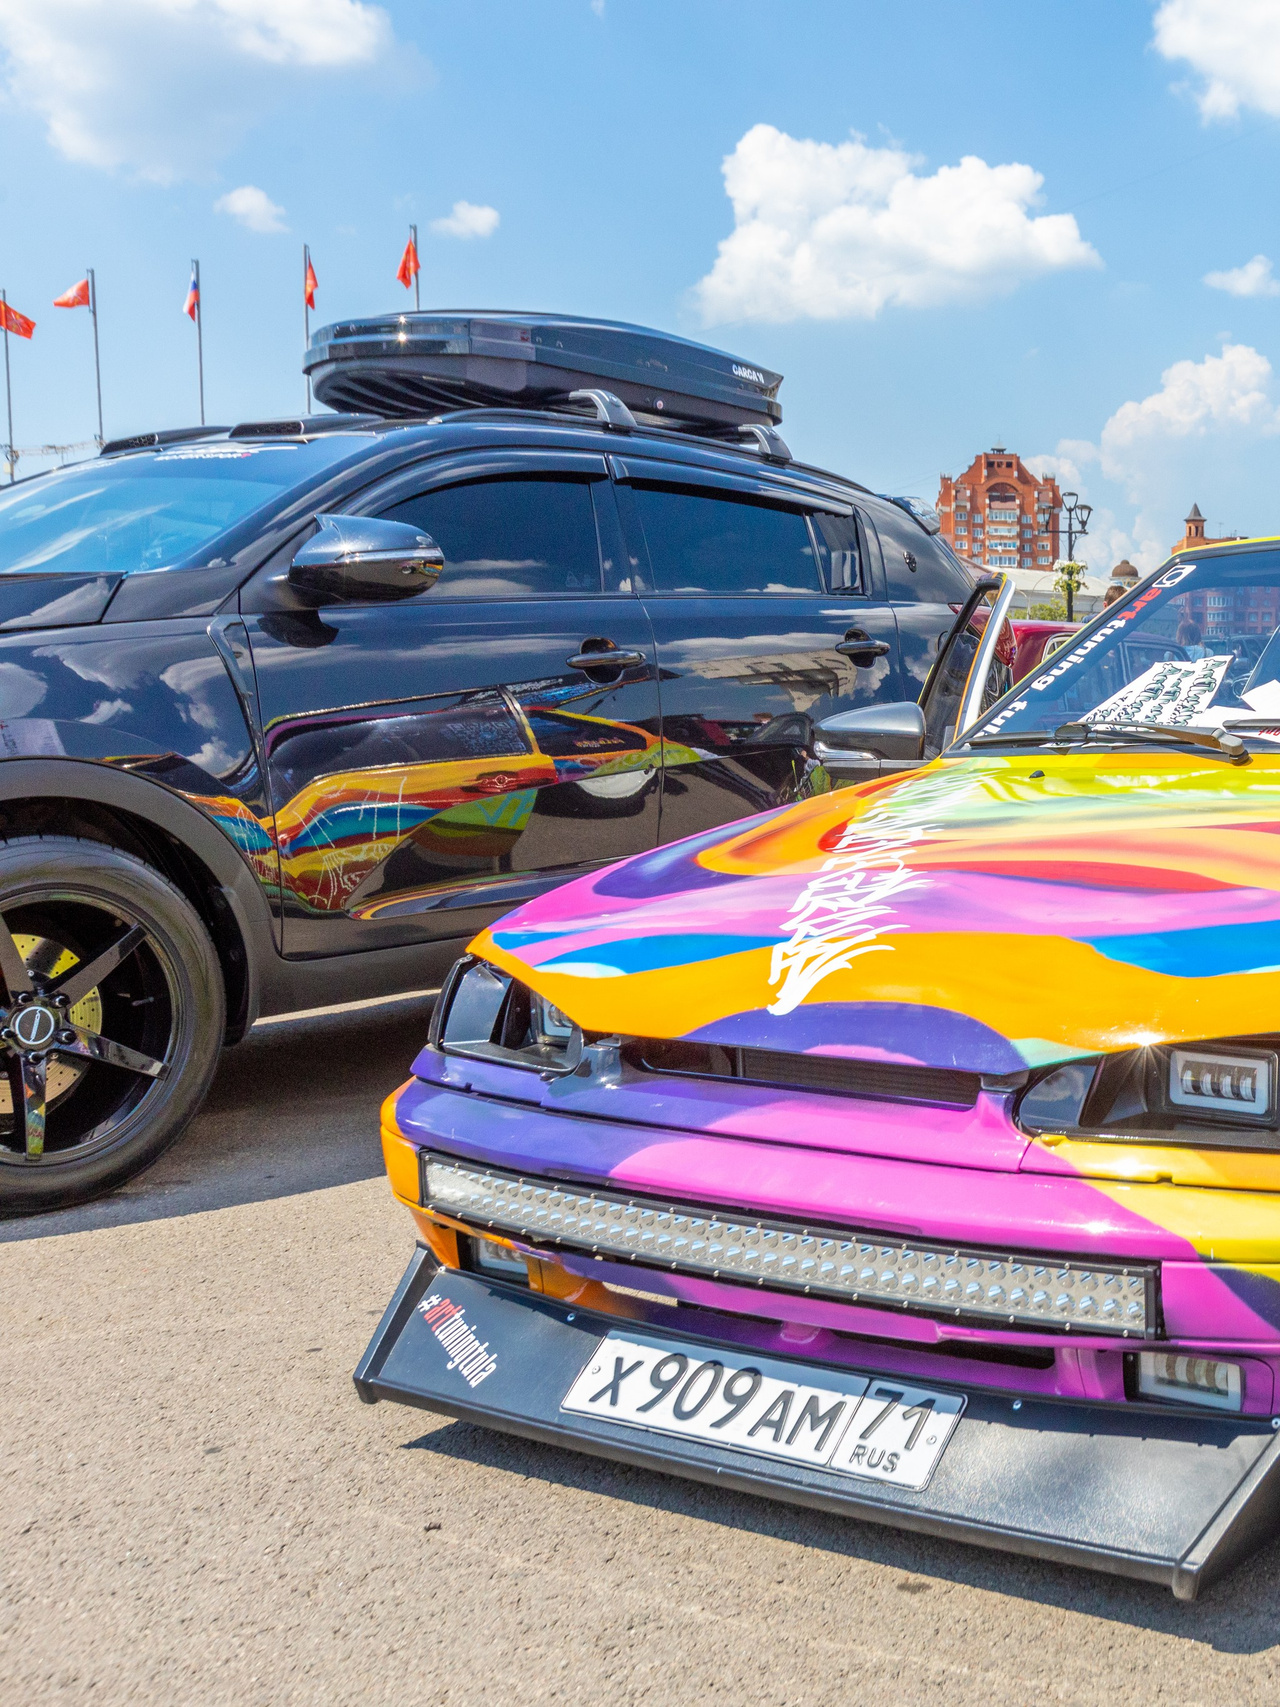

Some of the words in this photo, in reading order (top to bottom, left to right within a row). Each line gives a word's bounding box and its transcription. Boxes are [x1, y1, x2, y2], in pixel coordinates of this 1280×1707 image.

[417, 1294, 498, 1389] #arttuningtula
[858, 1387, 937, 1451] 71
[850, 1444, 900, 1473] RUS
